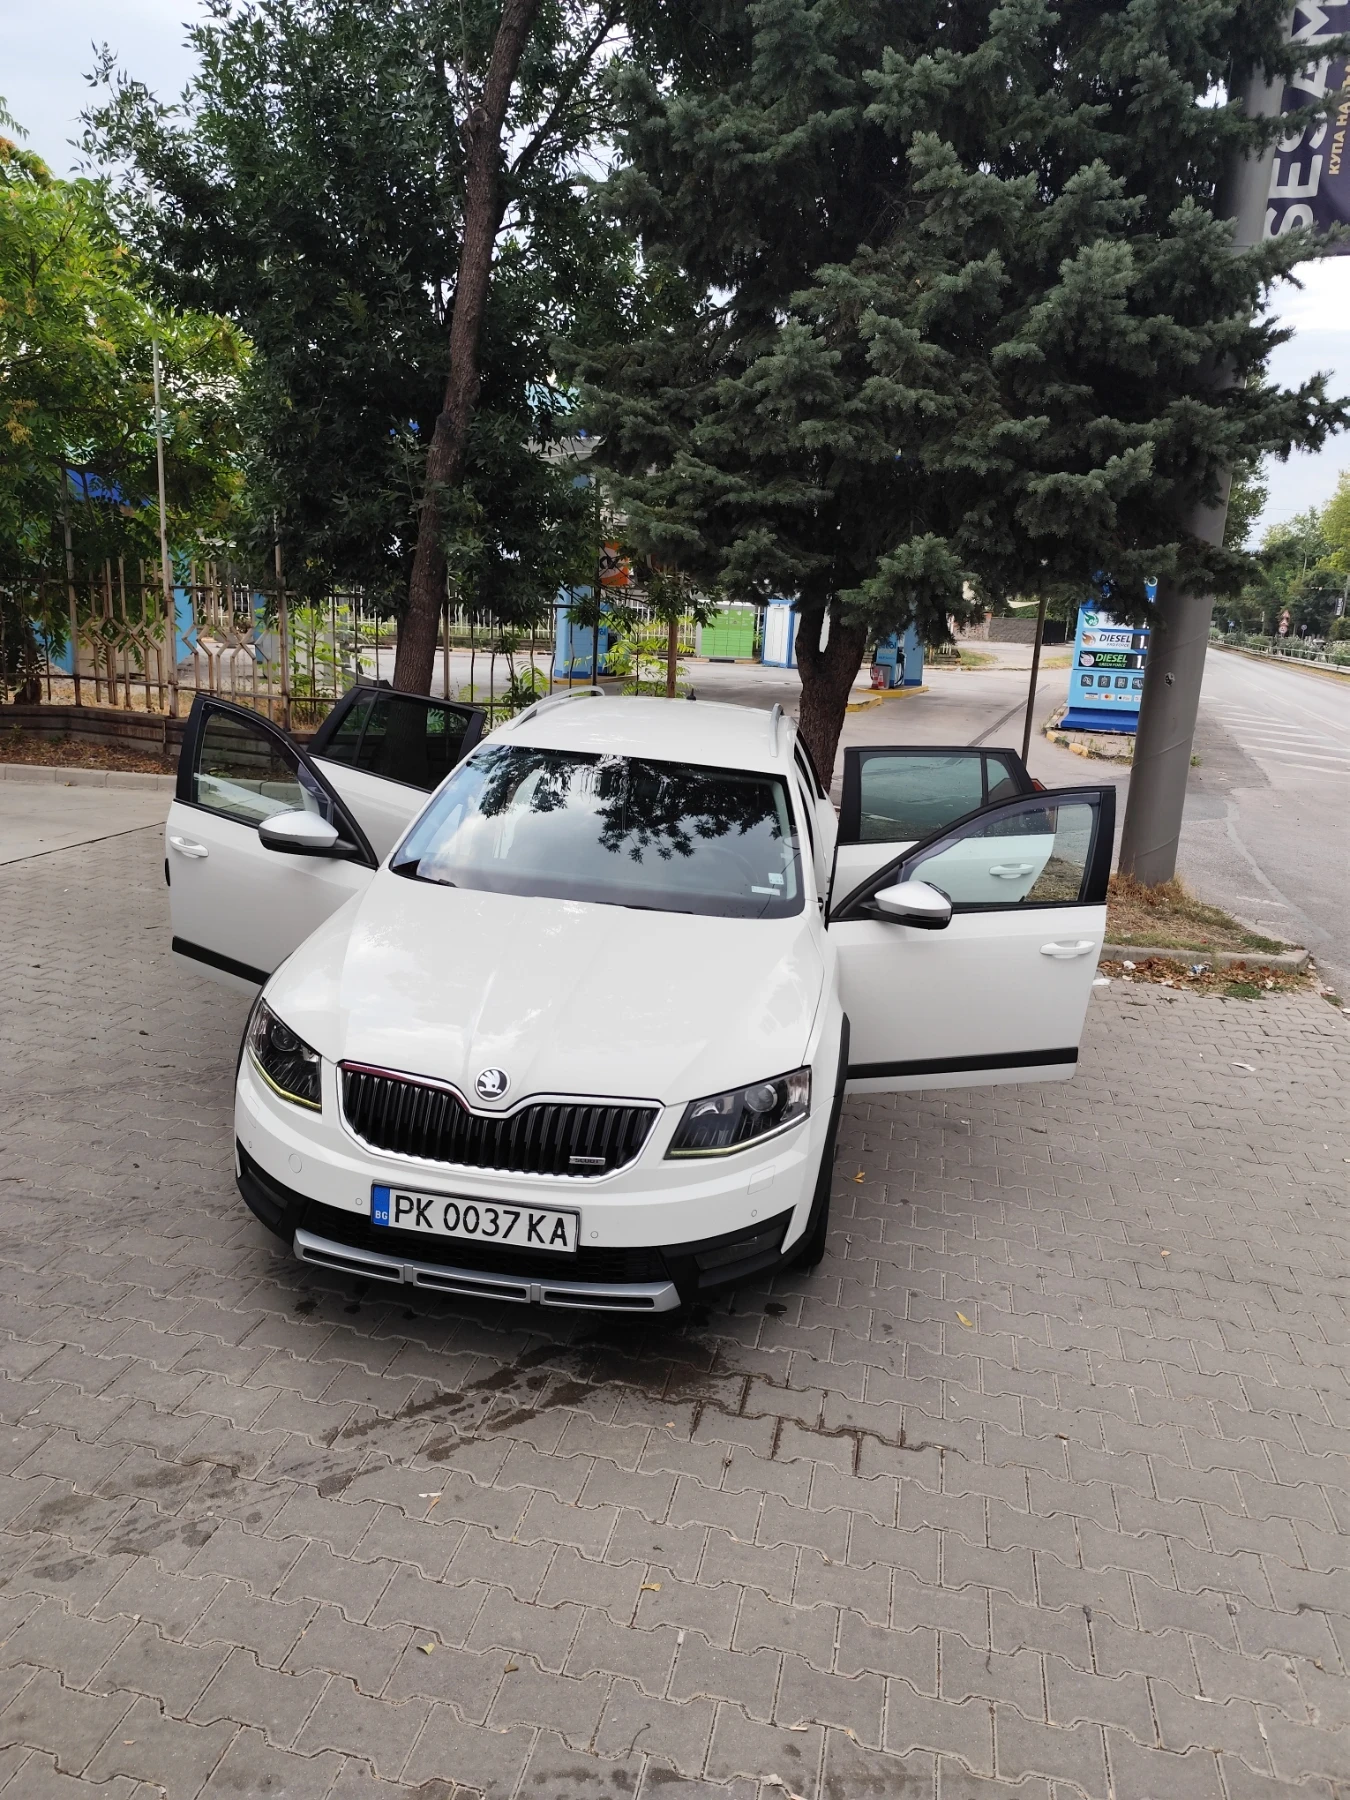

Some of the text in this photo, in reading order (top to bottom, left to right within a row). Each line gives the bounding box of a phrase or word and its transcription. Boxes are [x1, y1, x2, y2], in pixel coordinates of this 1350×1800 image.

[1336, 102, 1350, 126] НА
[1329, 130, 1346, 175] КУПА
[1099, 634, 1131, 643] DIESEL
[1095, 653, 1128, 663] DIESEL
[374, 1194, 568, 1247] BG PK 0037 KA
